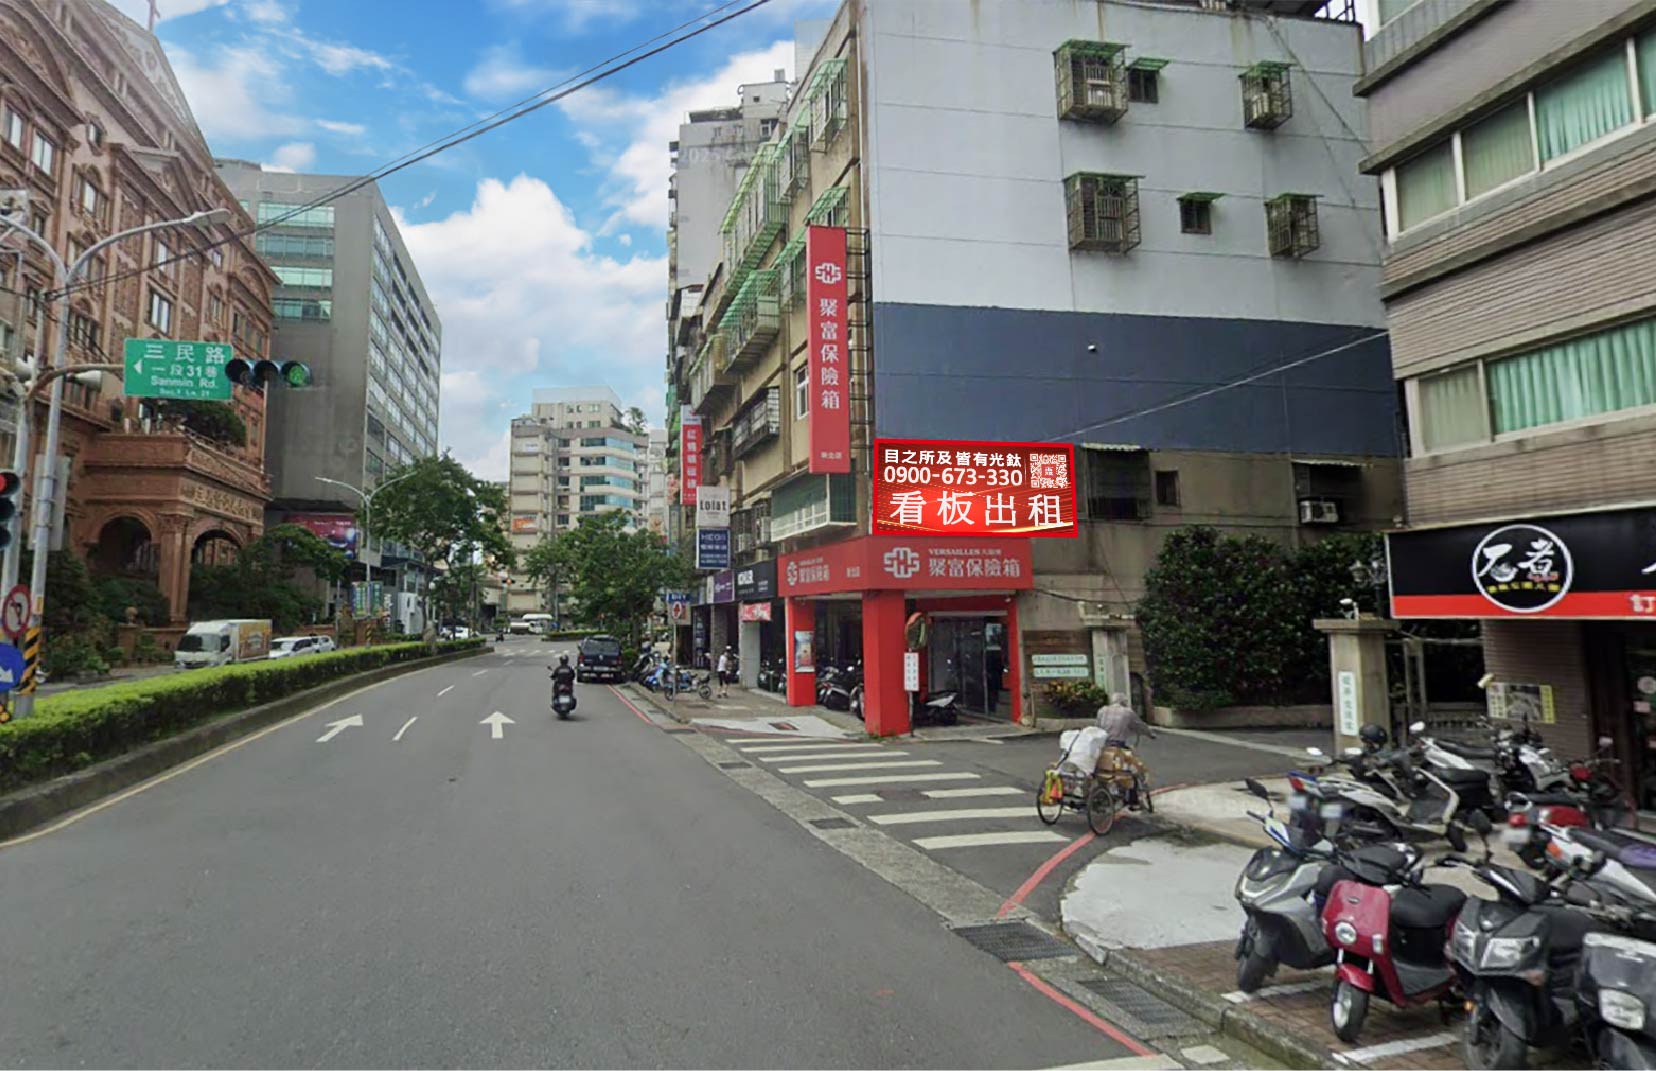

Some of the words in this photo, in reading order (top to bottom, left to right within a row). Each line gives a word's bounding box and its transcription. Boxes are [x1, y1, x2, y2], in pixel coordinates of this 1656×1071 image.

[144, 344, 224, 364] 三民路
[819, 298, 840, 409] 聚富保險箱
[151, 375, 193, 387] Sanmin
[884, 466, 1022, 486] 0900-673-330
[889, 490, 1065, 528] 看板出租
[929, 558, 1021, 577] 聚富保險箱
